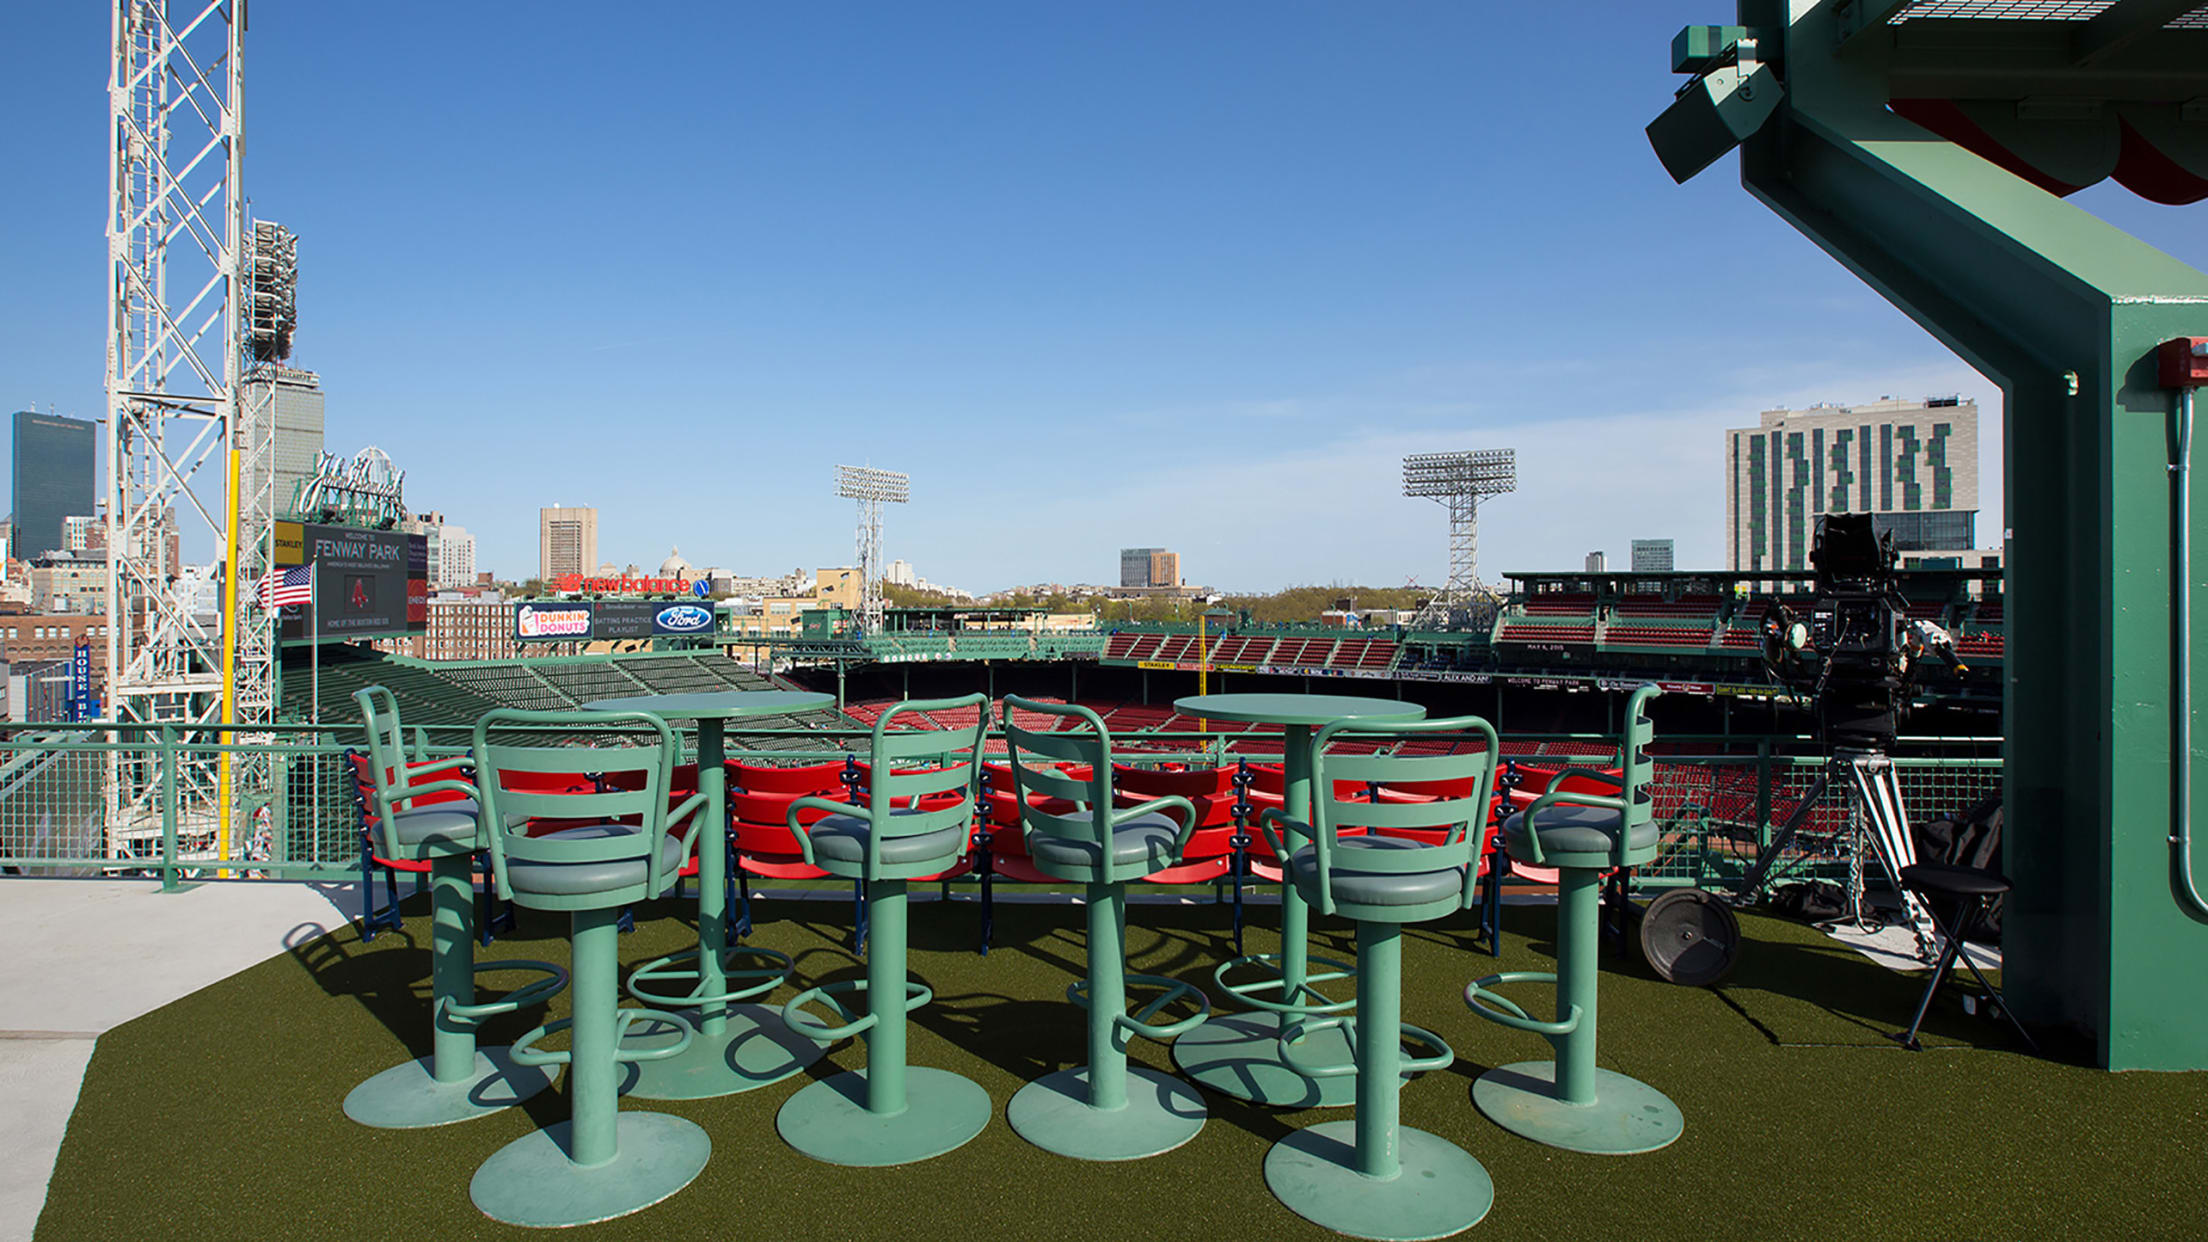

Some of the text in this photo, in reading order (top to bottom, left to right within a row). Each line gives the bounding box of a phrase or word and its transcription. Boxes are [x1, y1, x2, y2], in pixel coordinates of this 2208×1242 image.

[275, 539, 302, 548] STANLEY
[315, 539, 367, 559] FENWAY
[368, 543, 400, 560] PARK
[583, 578, 621, 592] new
[621, 574, 690, 592] balance
[540, 612, 588, 623] DUNKIN'
[667, 606, 701, 626] Ford
[540, 622, 586, 633] DONUTS
